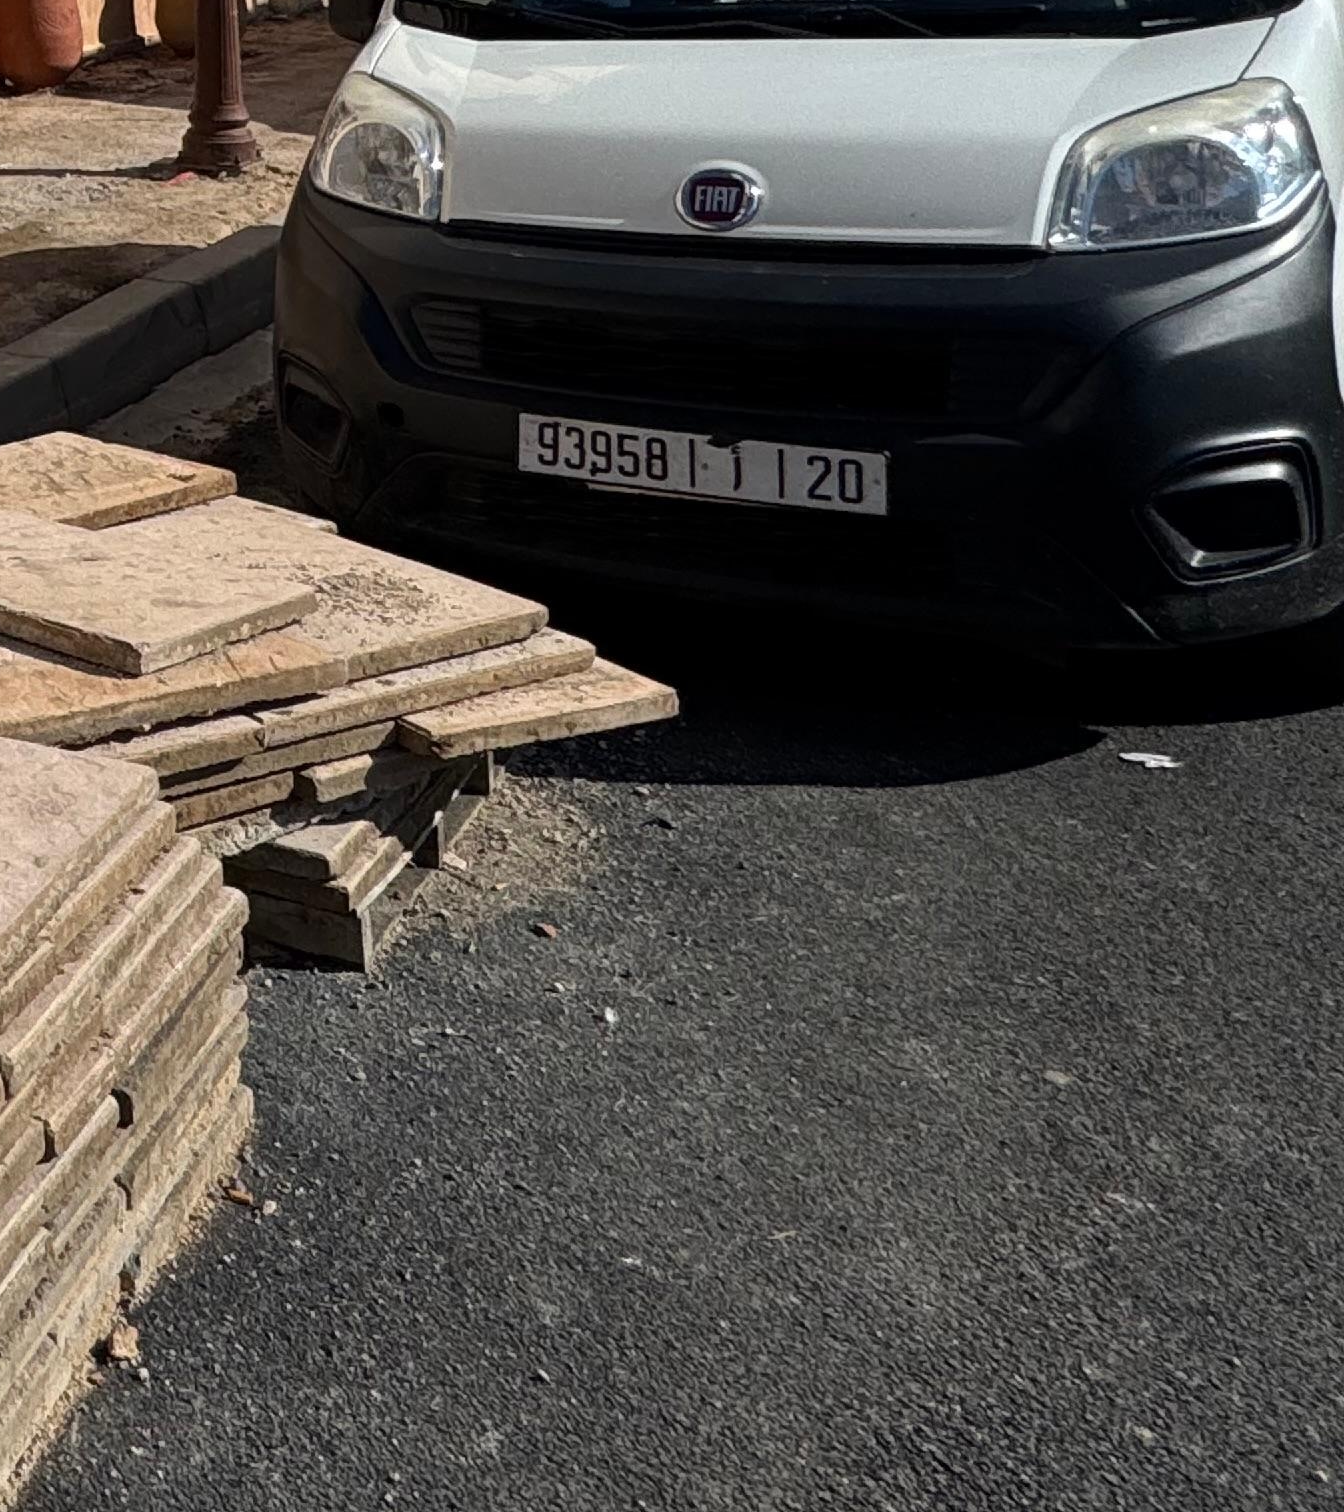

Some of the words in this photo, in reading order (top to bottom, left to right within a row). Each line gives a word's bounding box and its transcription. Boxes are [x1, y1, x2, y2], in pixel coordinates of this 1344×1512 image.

[694, 185, 742, 214] FIAT
[537, 421, 669, 482] 93958
[806, 454, 864, 505] 20
